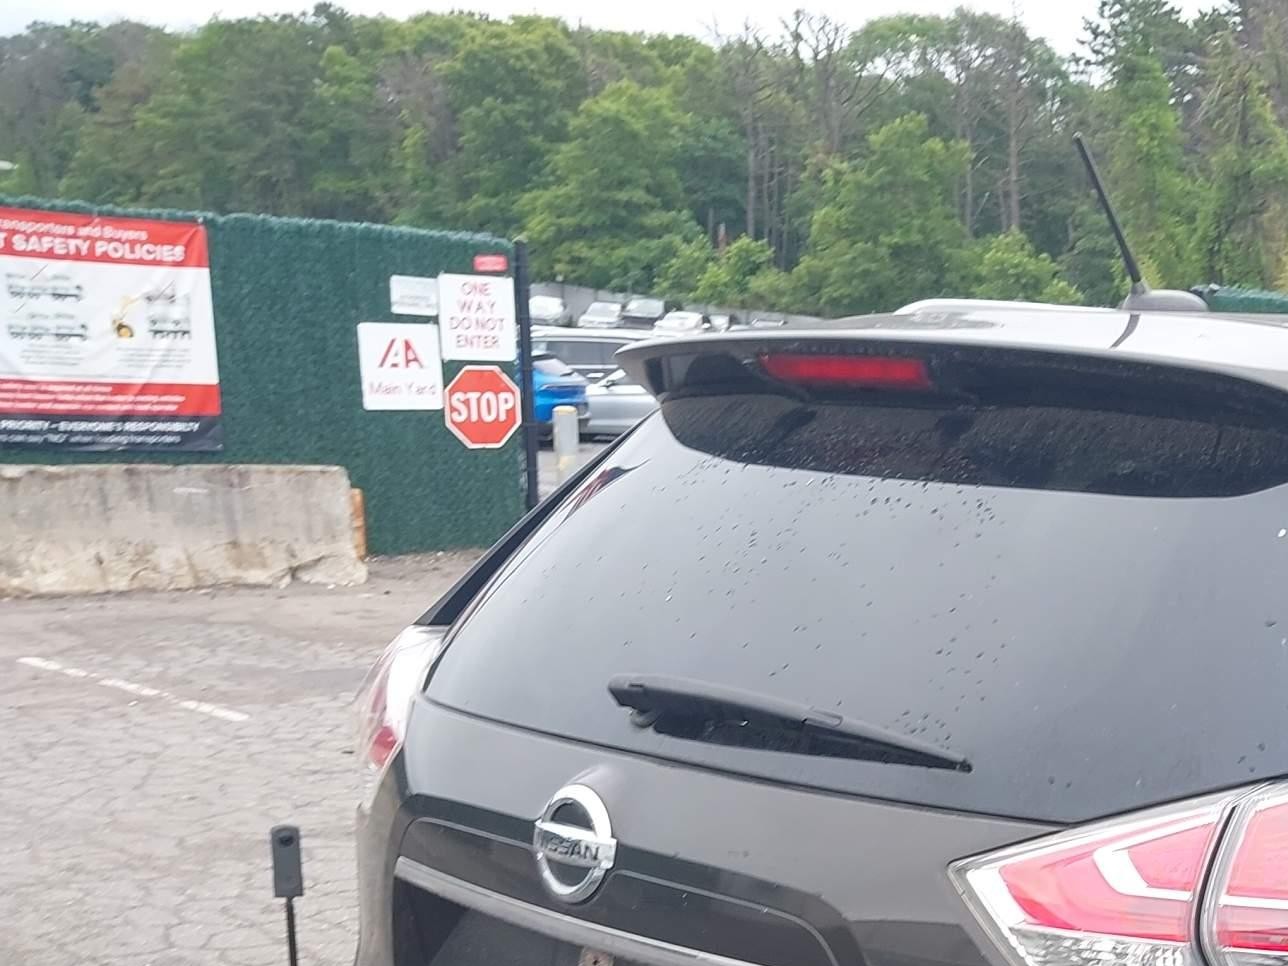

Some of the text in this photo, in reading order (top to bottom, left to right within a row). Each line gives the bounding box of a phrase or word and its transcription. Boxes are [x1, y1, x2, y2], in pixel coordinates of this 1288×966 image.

[12, 234, 90, 256] SAFETY
[95, 240, 186, 261] POLICIES
[461, 281, 491, 297] ONE
[458, 300, 497, 314] WAY
[450, 317, 505, 332] DO NOT
[455, 335, 500, 349] ENTER
[451, 391, 515, 423] STOP
